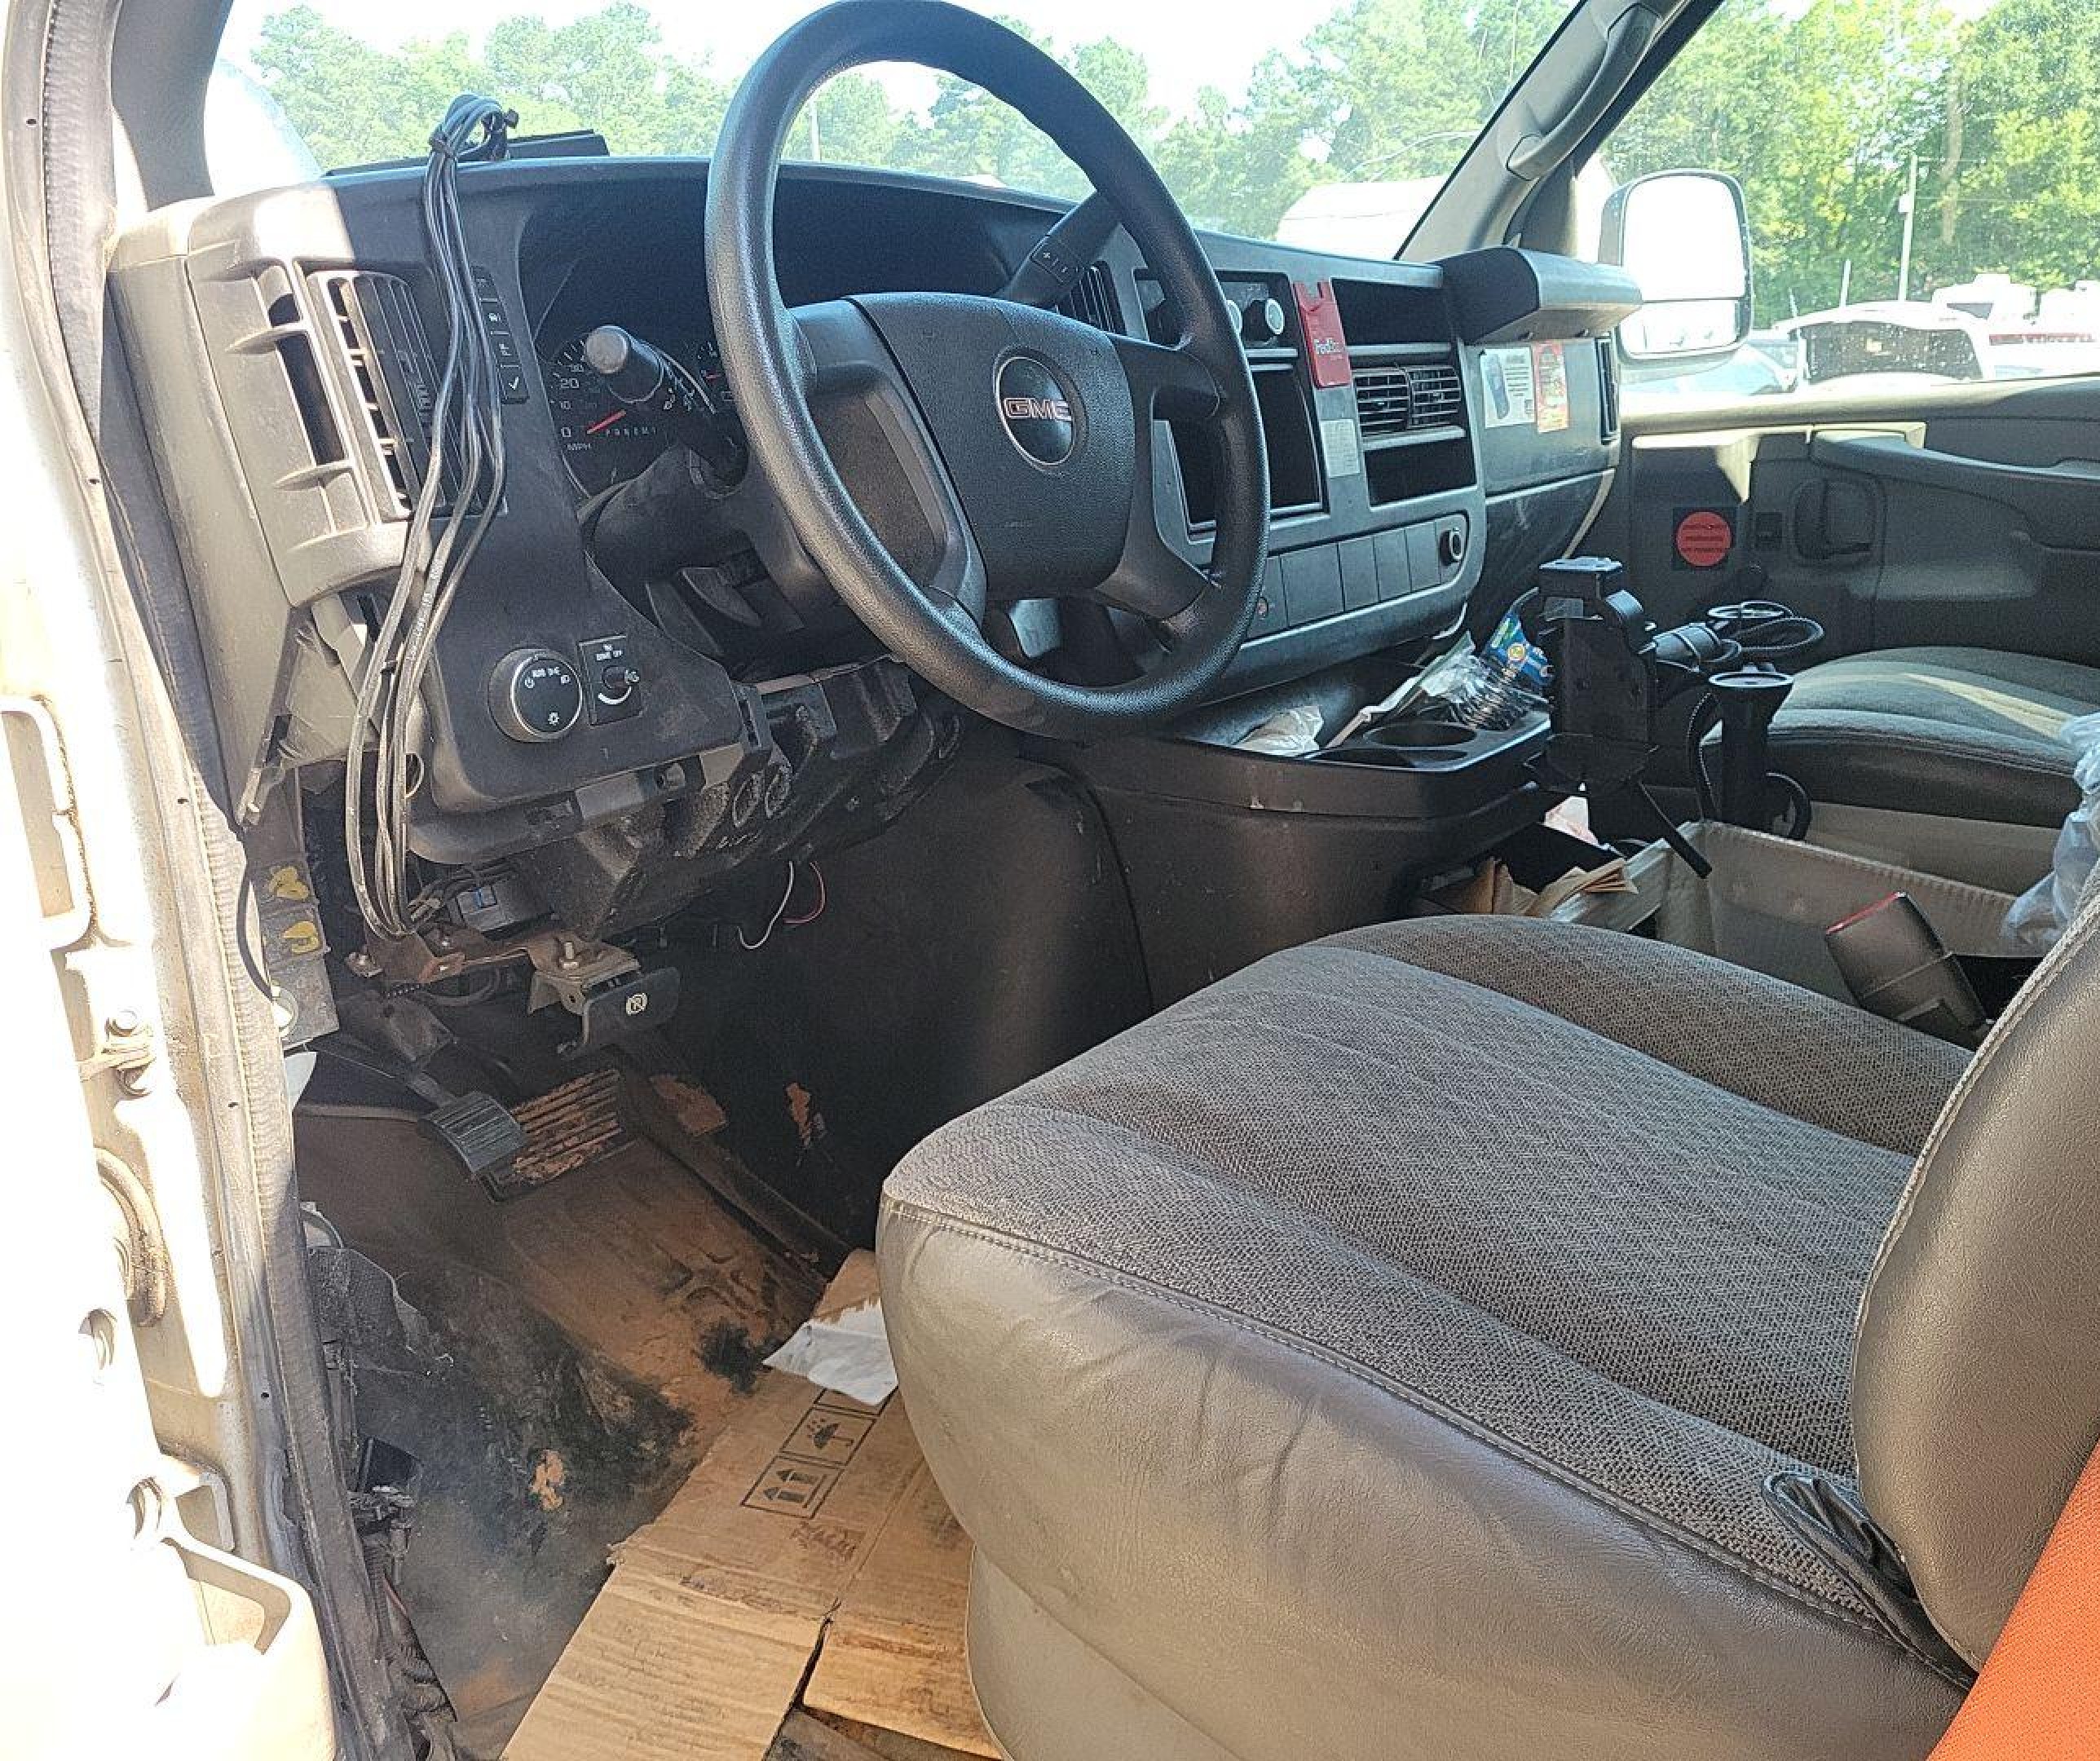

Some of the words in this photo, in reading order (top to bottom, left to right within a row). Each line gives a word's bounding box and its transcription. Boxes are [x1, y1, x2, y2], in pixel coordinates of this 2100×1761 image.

[560, 377, 580, 389] 20
[559, 400, 571, 410] 10
[1003, 397, 1072, 421] GMC
[560, 426, 571, 438] 0
[567, 443, 591, 451] MPH
